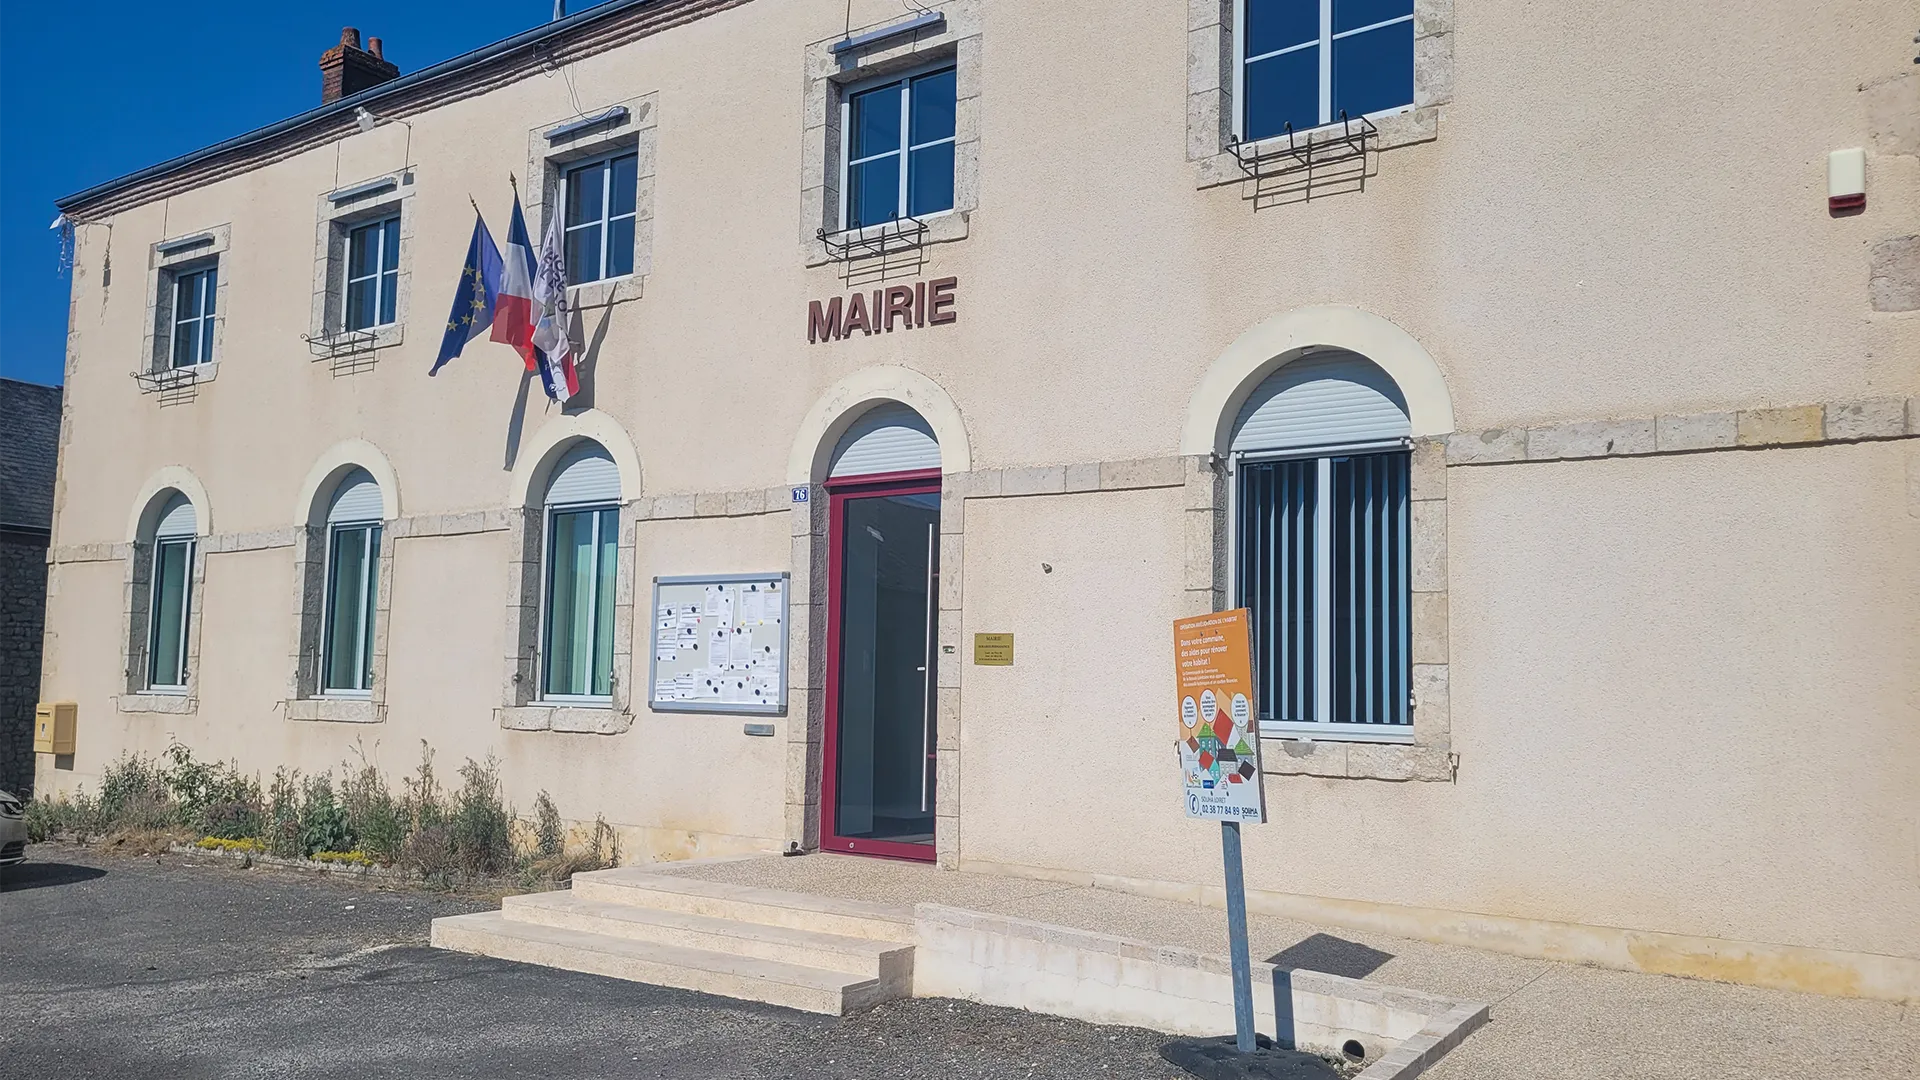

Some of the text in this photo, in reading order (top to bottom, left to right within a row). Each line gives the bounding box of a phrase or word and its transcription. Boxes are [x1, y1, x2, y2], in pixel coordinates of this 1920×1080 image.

[807, 276, 958, 344] MAIRIE
[795, 489, 805, 500] 76
[1181, 639, 1191, 647] Dans
[1191, 637, 1202, 645] votre
[1189, 648, 1200, 656] aides
[1200, 647, 1211, 656] pour
[1211, 645, 1228, 653] rénover
[1182, 660, 1193, 668] votre
[1193, 657, 1208, 666] habitat
[1202, 805, 1240, 815] 02 38 77 84 89
